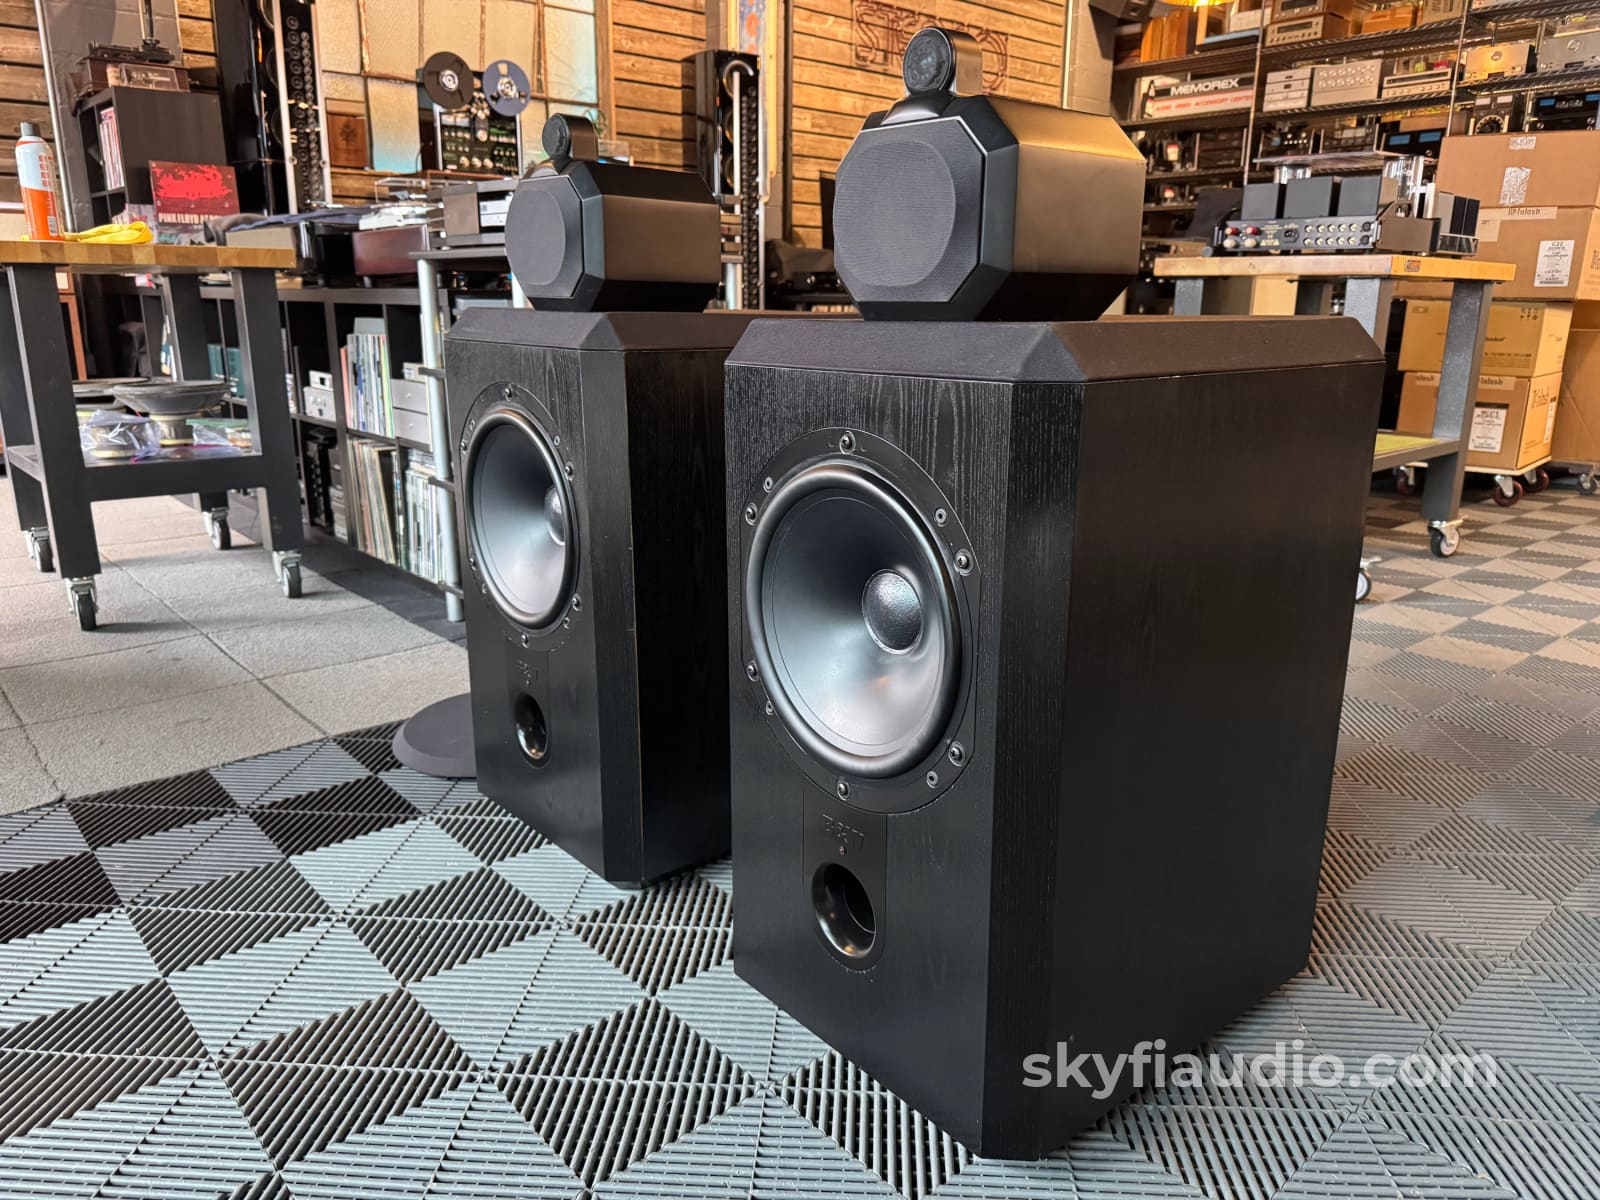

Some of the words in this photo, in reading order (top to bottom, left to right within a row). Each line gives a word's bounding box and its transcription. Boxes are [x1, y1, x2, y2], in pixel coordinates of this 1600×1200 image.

[1170, 78, 1240, 96] MEMOREX
[158, 212, 177, 223] PINK
[177, 213, 200, 224] FLOYD
